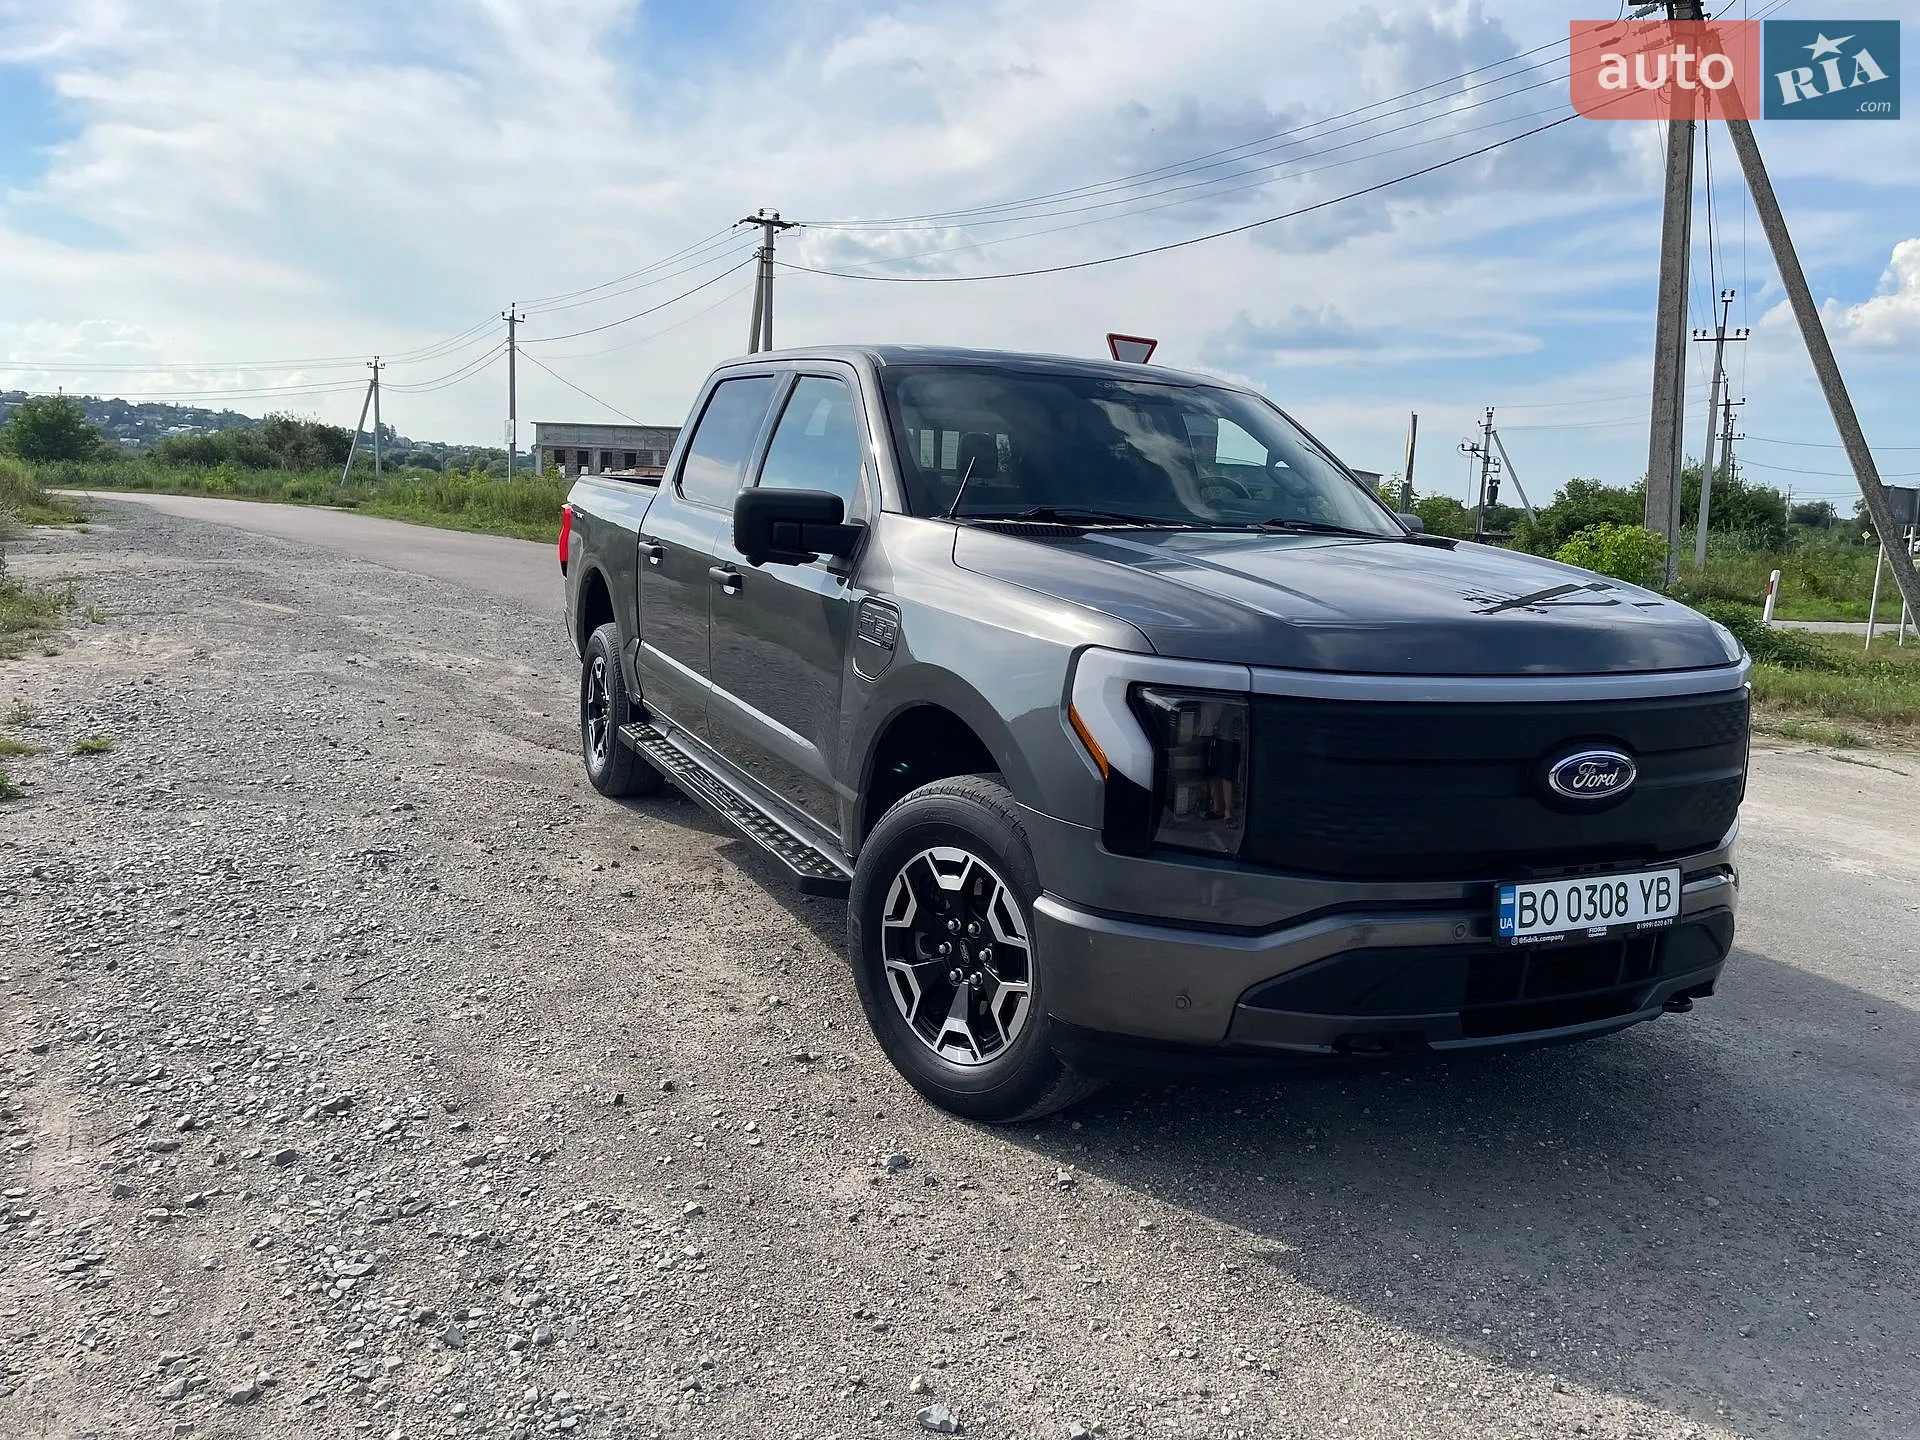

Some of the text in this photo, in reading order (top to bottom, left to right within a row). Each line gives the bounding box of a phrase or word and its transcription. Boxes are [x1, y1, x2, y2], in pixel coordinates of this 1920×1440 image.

[1572, 761, 1620, 789] Ford
[1518, 876, 1672, 929] BO 0308 YB
[1500, 917, 1513, 930] UA
